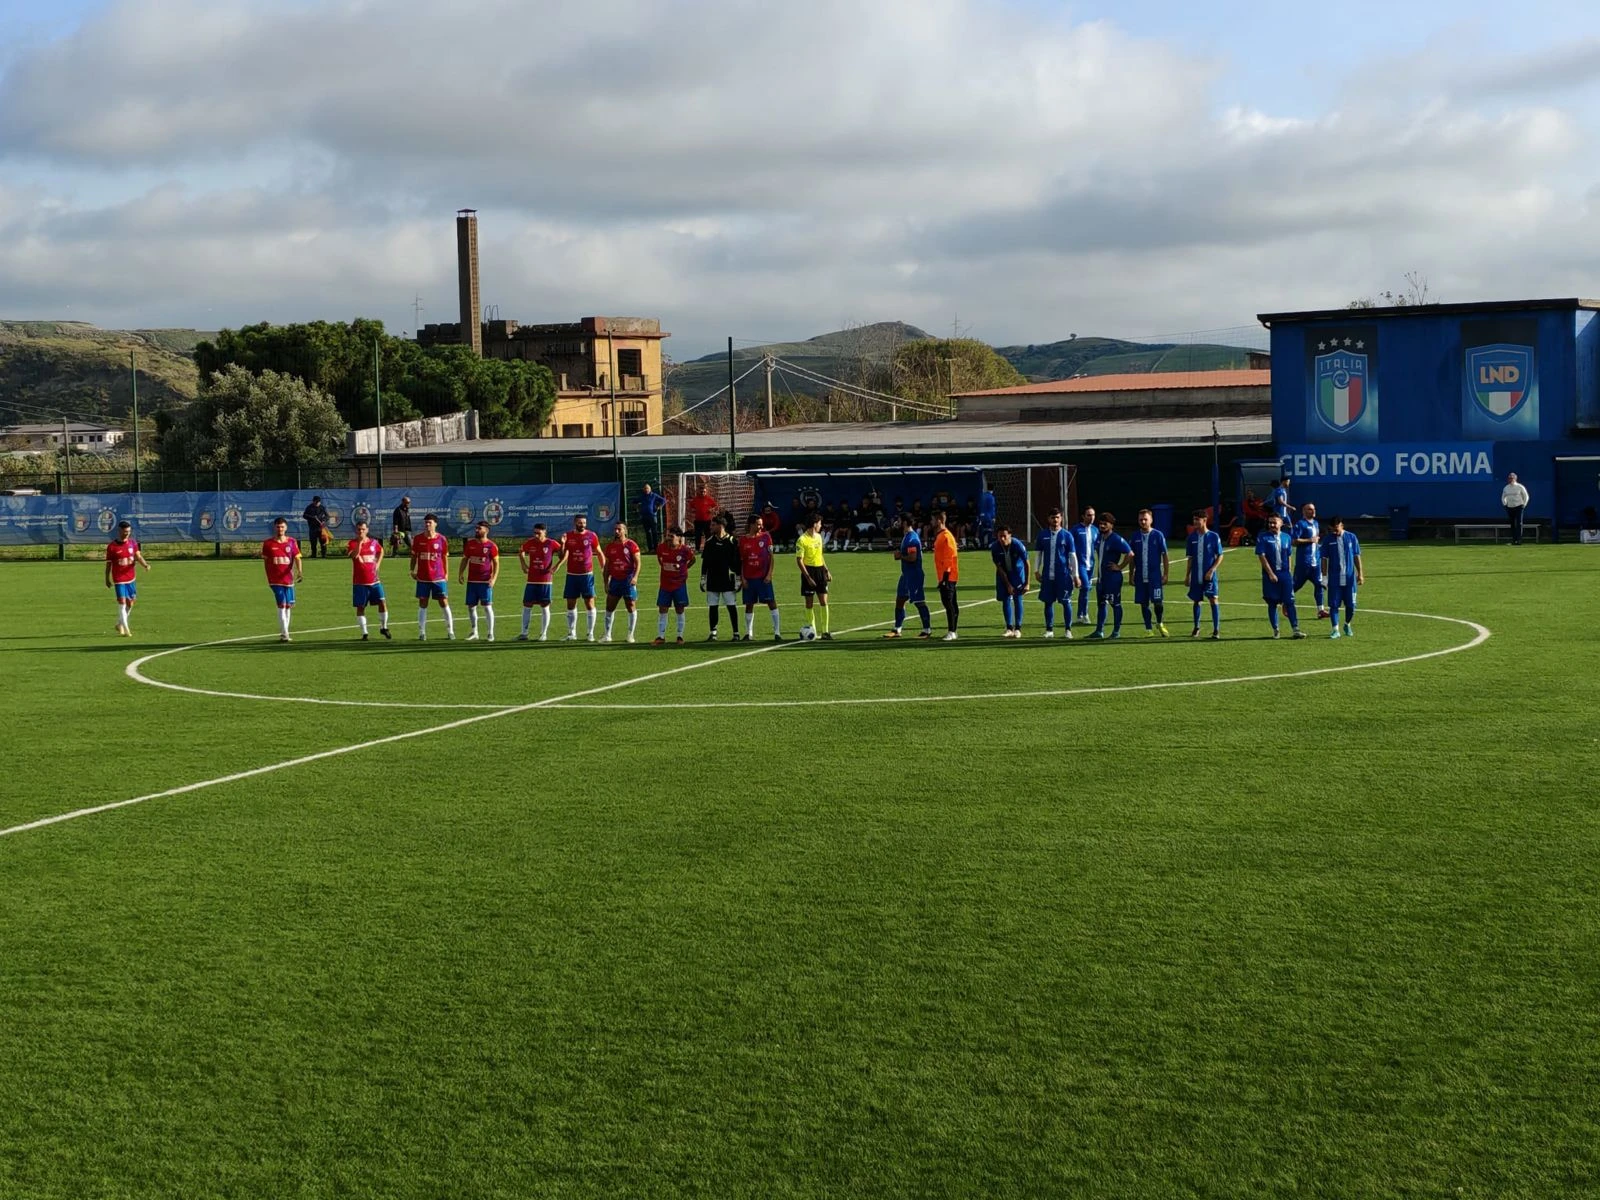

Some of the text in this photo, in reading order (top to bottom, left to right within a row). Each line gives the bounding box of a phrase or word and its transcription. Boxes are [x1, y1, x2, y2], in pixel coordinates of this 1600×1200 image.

[1320, 359, 1362, 372] ITALIA
[1480, 365, 1520, 384] LND
[1395, 452, 1492, 475] FORMA
[1153, 588, 1161, 599] 10
